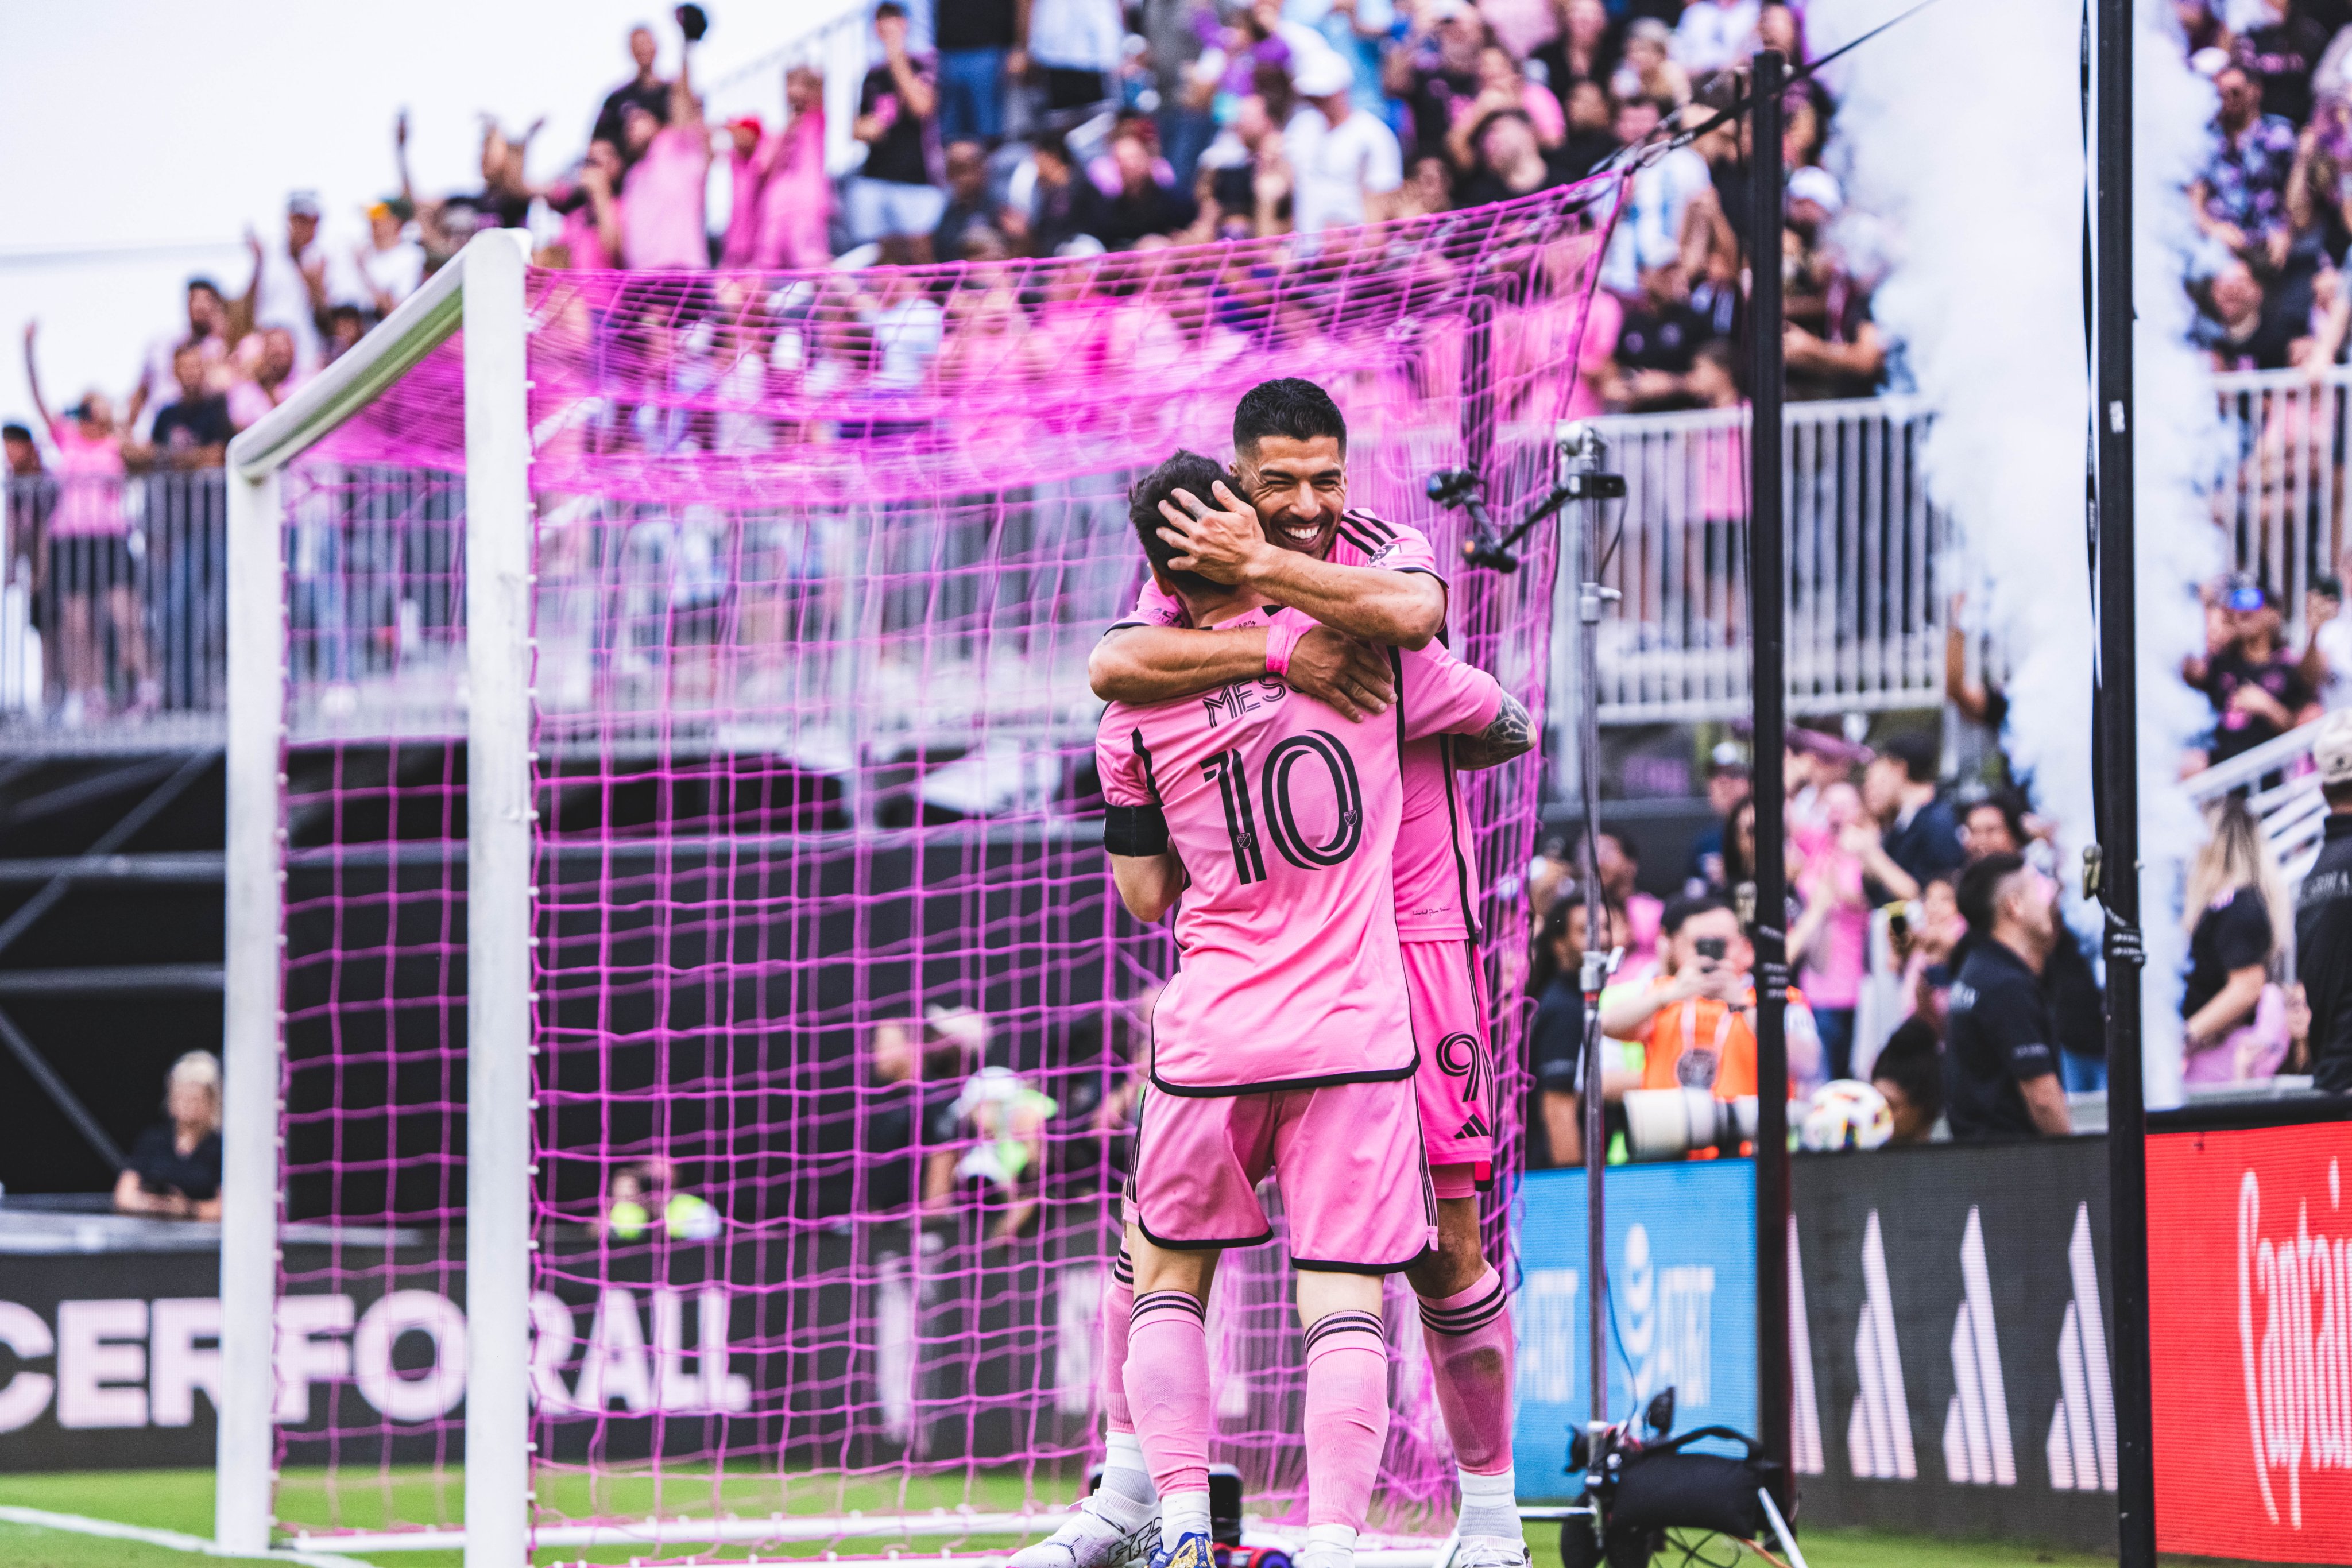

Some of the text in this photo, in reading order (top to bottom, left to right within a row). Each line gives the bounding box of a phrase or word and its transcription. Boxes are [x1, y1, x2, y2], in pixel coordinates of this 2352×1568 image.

[1202, 671, 1305, 729] MES
[1199, 729, 1363, 885] 10
[1436, 1031, 1480, 1102] 9
[2238, 1155, 2352, 1531] Captai
